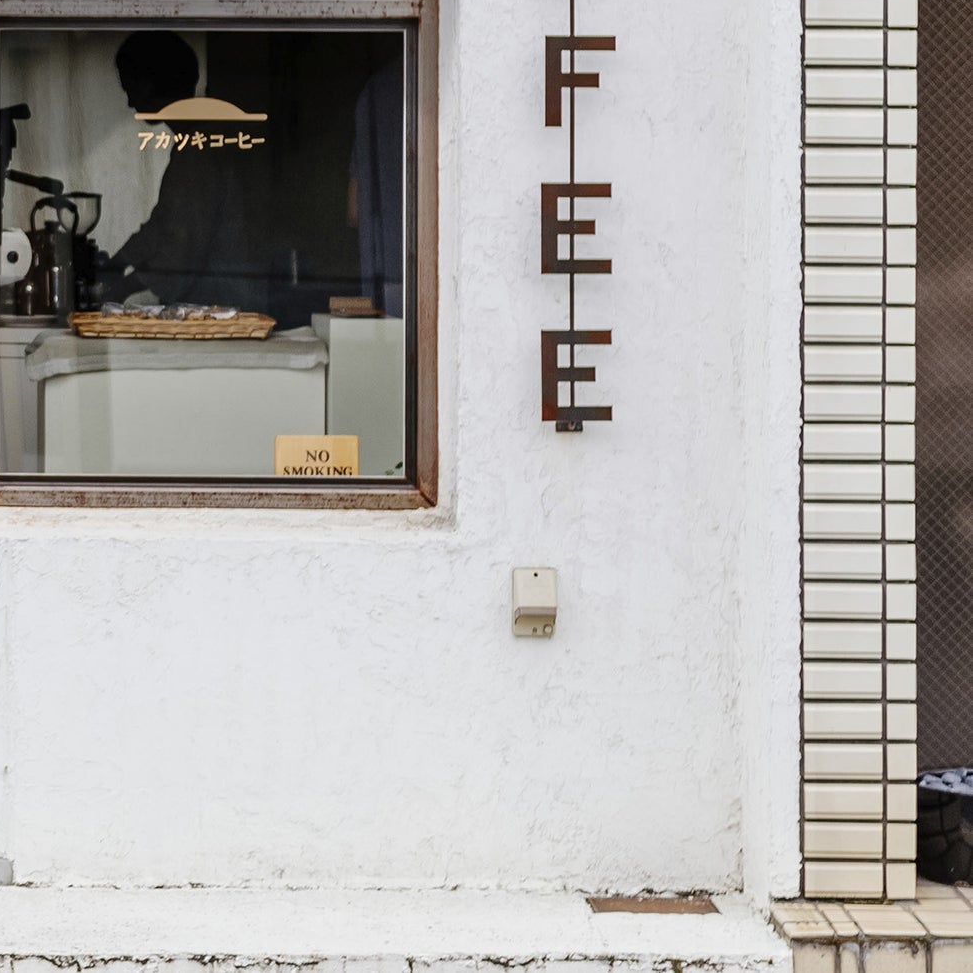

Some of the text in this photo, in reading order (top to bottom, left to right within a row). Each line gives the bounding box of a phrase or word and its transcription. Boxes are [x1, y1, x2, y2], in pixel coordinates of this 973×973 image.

[137, 131, 266, 151] アカツキコーヒー
[305, 449, 330, 463] NO
[283, 466, 353, 475] SMOKING
